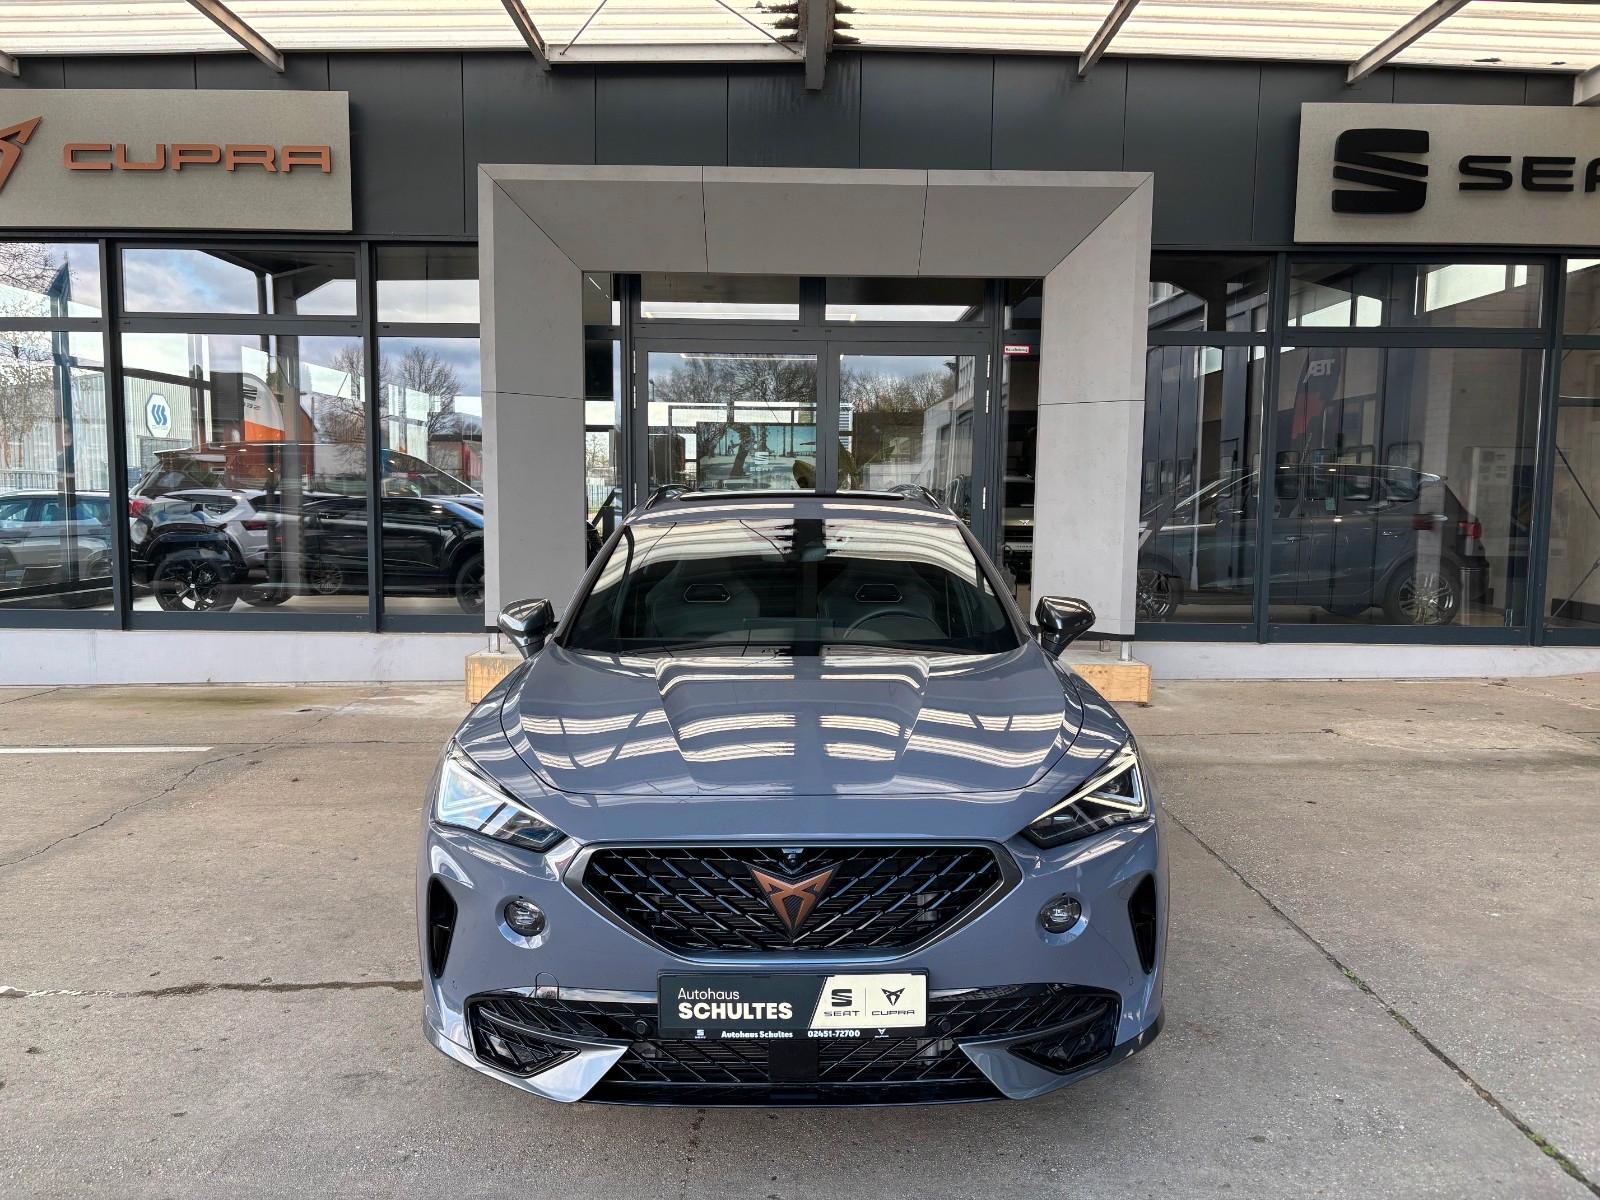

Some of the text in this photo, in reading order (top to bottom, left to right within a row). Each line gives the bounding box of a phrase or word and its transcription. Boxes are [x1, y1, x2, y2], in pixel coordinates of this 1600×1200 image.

[63, 143, 331, 174] CUPRA
[677, 987, 740, 1000] Autohaus
[678, 1002, 793, 1020] SCHULTES
[720, 1030, 794, 1039] Autohaus Schultes
[807, 1029, 861, 1038] 02451-72700
